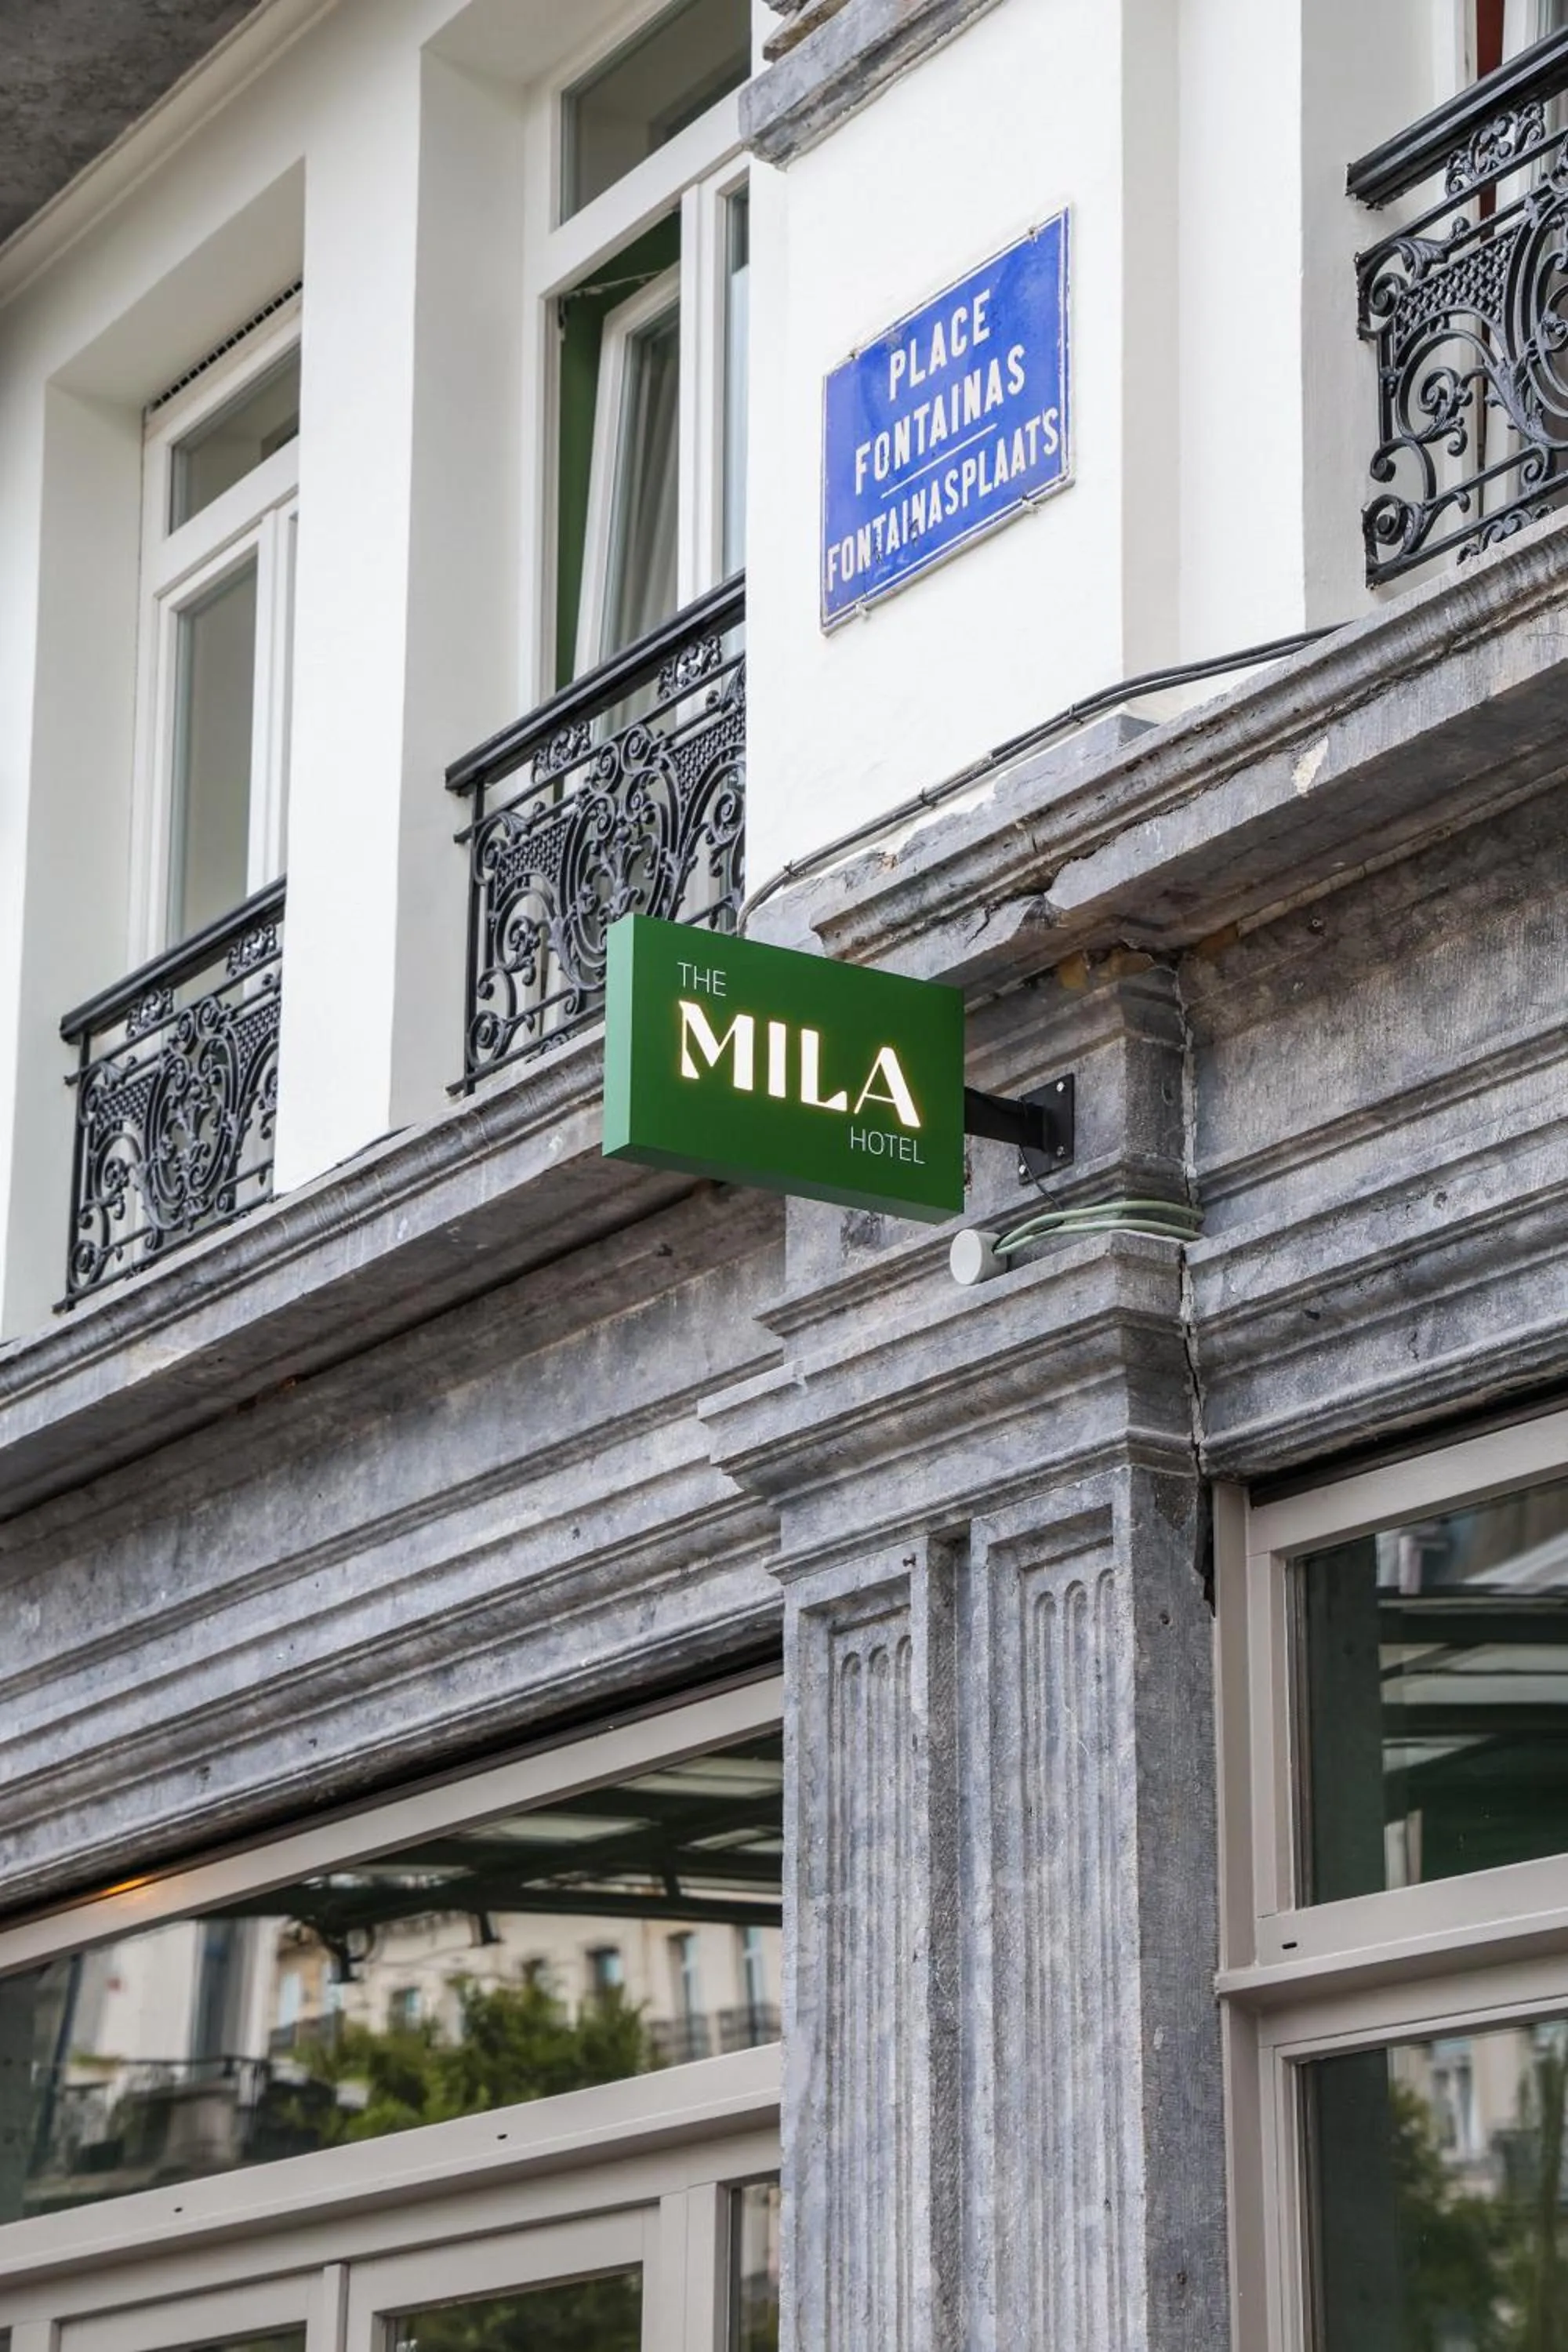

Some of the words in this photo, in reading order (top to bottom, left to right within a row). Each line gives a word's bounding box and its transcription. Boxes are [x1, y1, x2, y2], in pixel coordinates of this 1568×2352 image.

[889, 289, 991, 401] PLACE
[855, 344, 1025, 495] FONTAINAS
[827, 407, 1059, 592] FONTAINASPLAATS
[677, 962, 727, 996] THE
[678, 1000, 921, 1128] MILA
[850, 1127, 925, 1164] HOTEL
